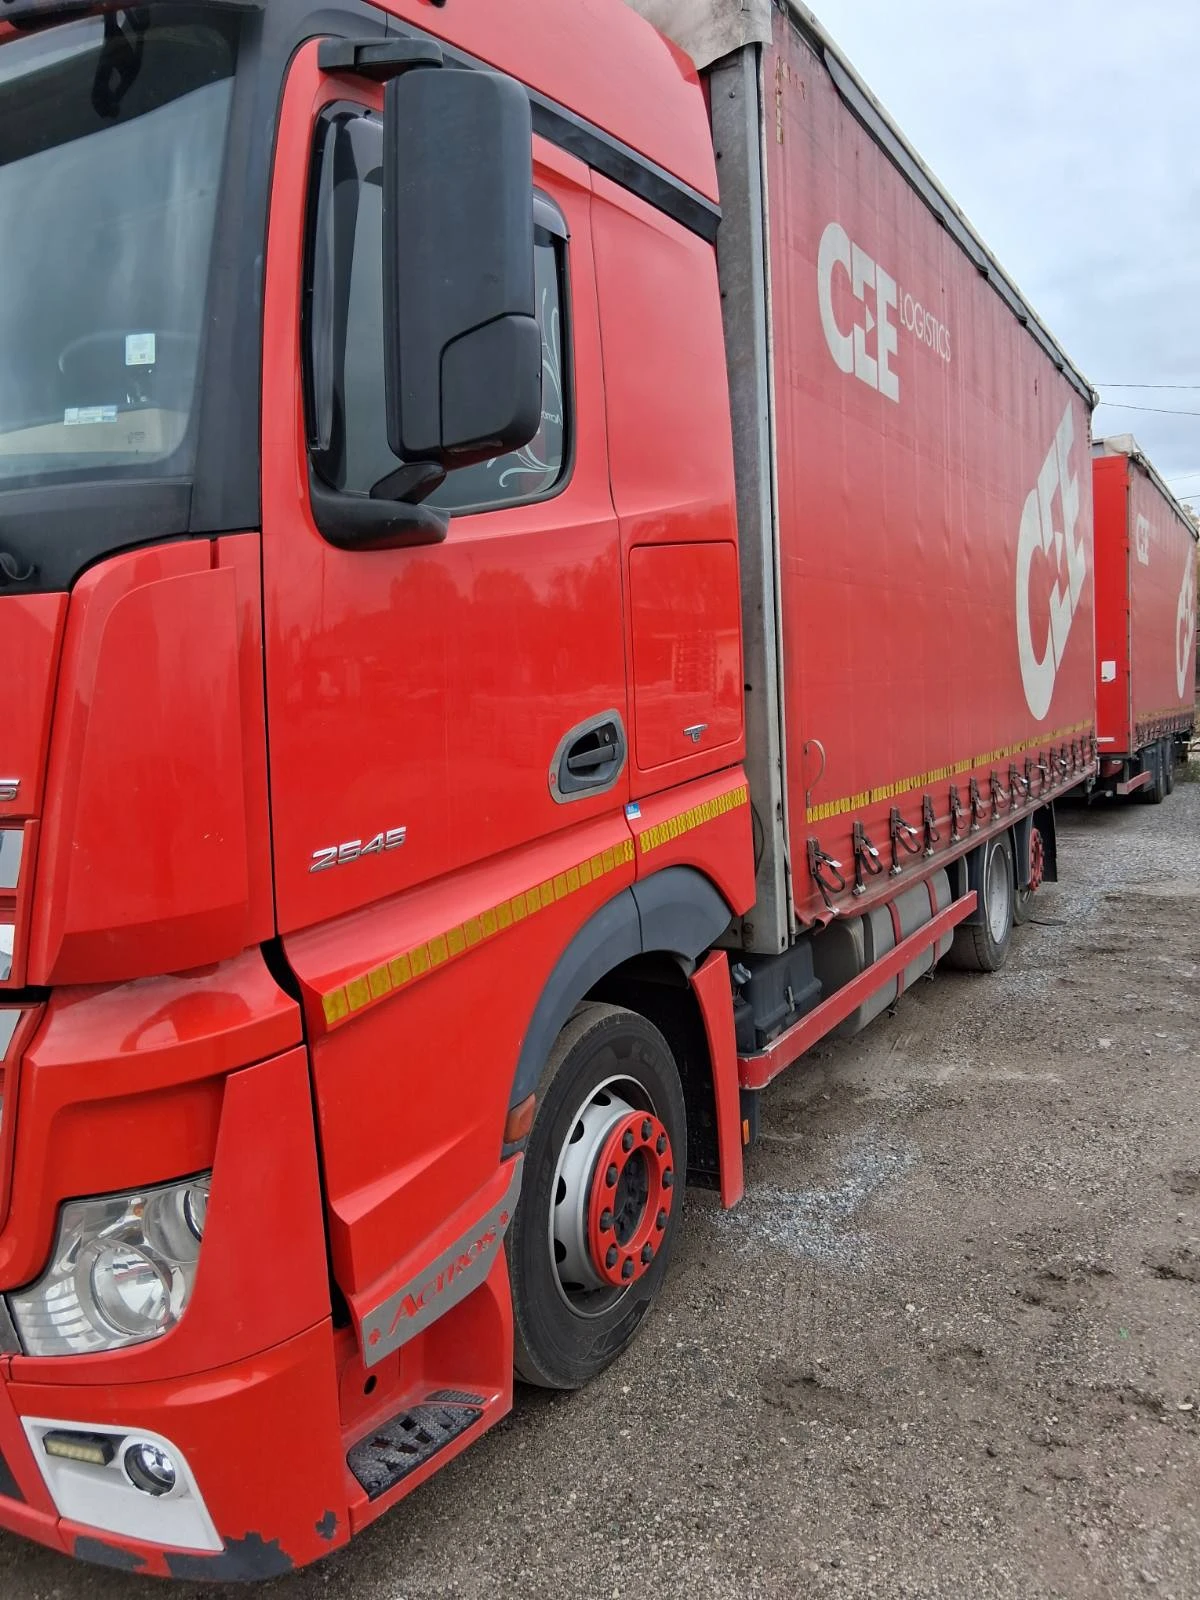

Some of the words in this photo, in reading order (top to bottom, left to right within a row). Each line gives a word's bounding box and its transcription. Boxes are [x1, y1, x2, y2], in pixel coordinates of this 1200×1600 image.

[817, 221, 899, 404] CEE
[900, 287, 951, 362] LOGISTICS
[309, 826, 407, 873] 2545
